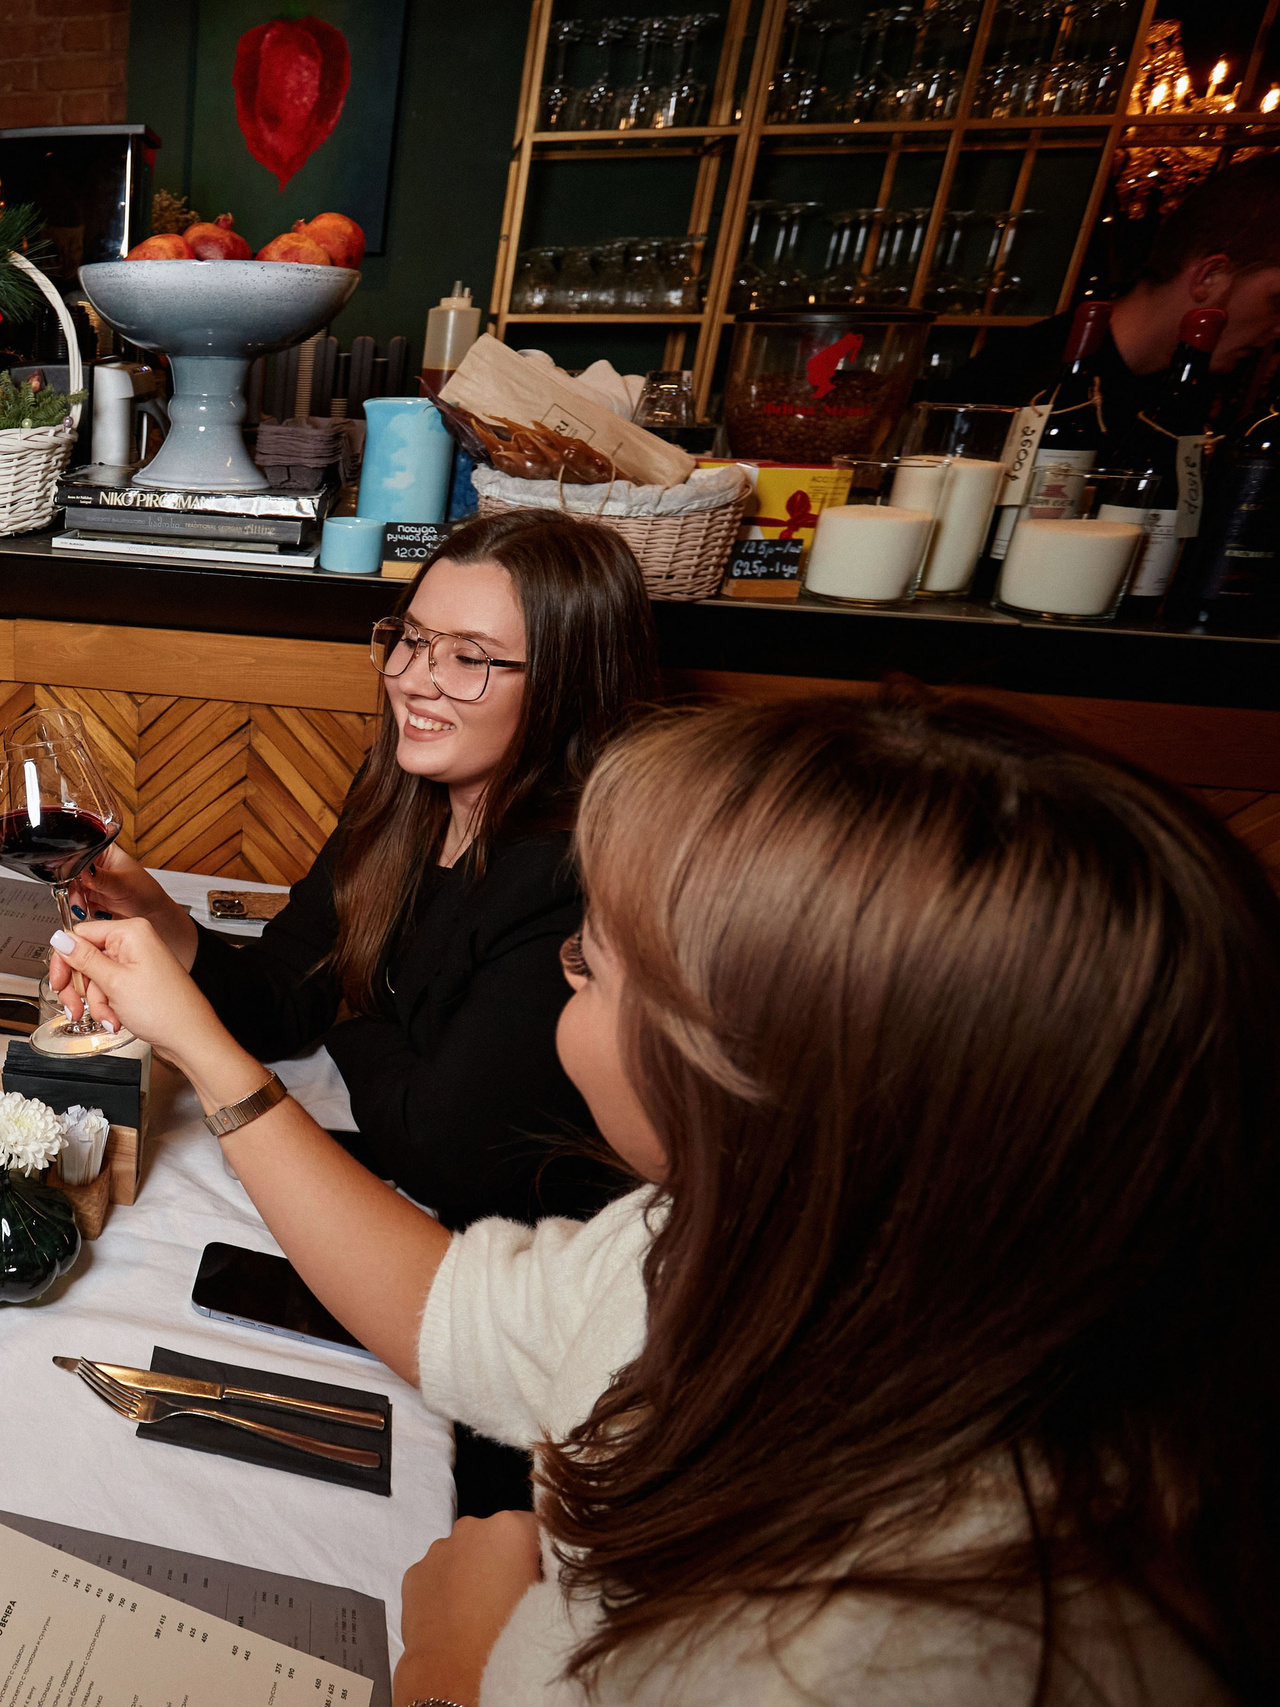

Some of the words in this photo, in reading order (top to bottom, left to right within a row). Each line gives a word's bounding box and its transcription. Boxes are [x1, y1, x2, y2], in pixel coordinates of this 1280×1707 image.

[554, 419, 570, 438] RI
[100, 491, 133, 507] NIKO
[136, 493, 213, 511] PIROMAN
[397, 525, 437, 535] Посуда
[387, 533, 420, 542] ручной
[73, 1578, 81, 1588] 395
[84, 1583, 92, 1593] 475
[118, 1597, 126, 1608] 750
[130, 1602, 138, 1613] 550
[0, 1601, 17, 1628] ВЕЧЕРА
[11, 1644, 25, 1670] судаком
[51, 1569, 59, 1578] 175
[159, 1615, 167, 1625] 415
[176, 1622, 185, 1633] 550
[189, 1627, 197, 1638] 625
[9, 1680, 24, 1707] рускетта
[62, 1574, 70, 1583] 175
[201, 1632, 209, 1643] 450
[70, 1666, 85, 1696] баклажан
[85, 1638, 97, 1661] соусом
[107, 1593, 115, 1603] 450
[231, 1645, 239, 1656] 450
[60, 1660, 74, 1688] орехами
[287, 1667, 295, 1679] 590
[268, 1681, 277, 1706] соусом
[340, 1689, 348, 1700] 585
